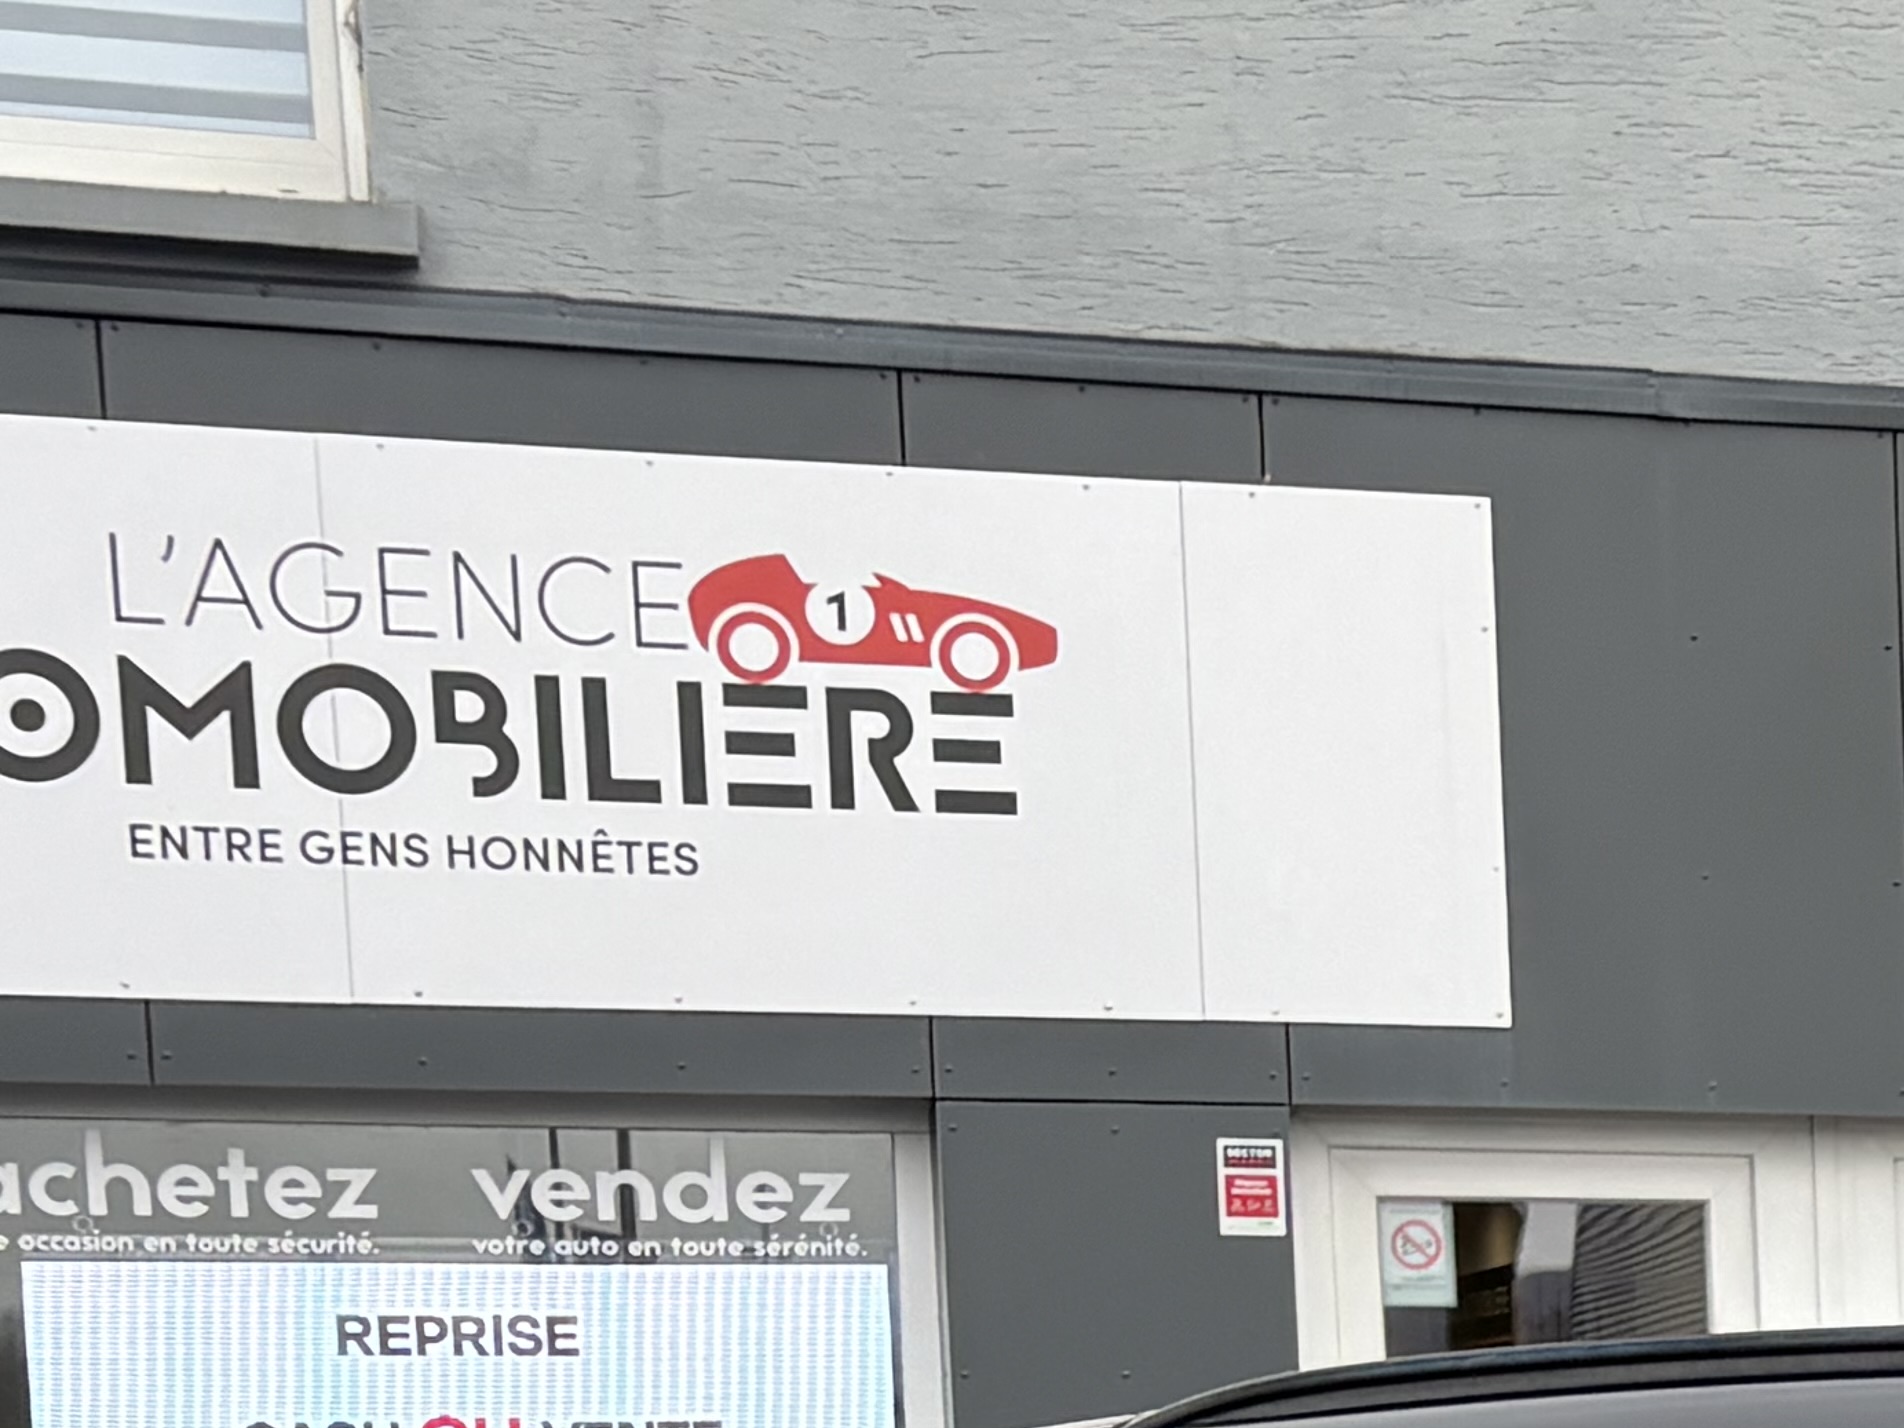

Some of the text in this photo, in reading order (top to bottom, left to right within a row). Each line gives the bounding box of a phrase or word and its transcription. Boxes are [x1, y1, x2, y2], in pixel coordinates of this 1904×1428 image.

[108, 531, 687, 649] L'AGENCE
[826, 590, 847, 632] 1
[128, 823, 700, 876] ENTRE GENS HONNÊTES
[471, 1135, 851, 1223] vendez
[17, 1229, 135, 1252] occasion
[144, 1234, 177, 1252] en
[185, 1232, 259, 1253] toute
[267, 1229, 381, 1255] sécurité.
[472, 1232, 869, 1258] votre auto en toute sérénité.
[336, 1314, 581, 1357] REPRISE
